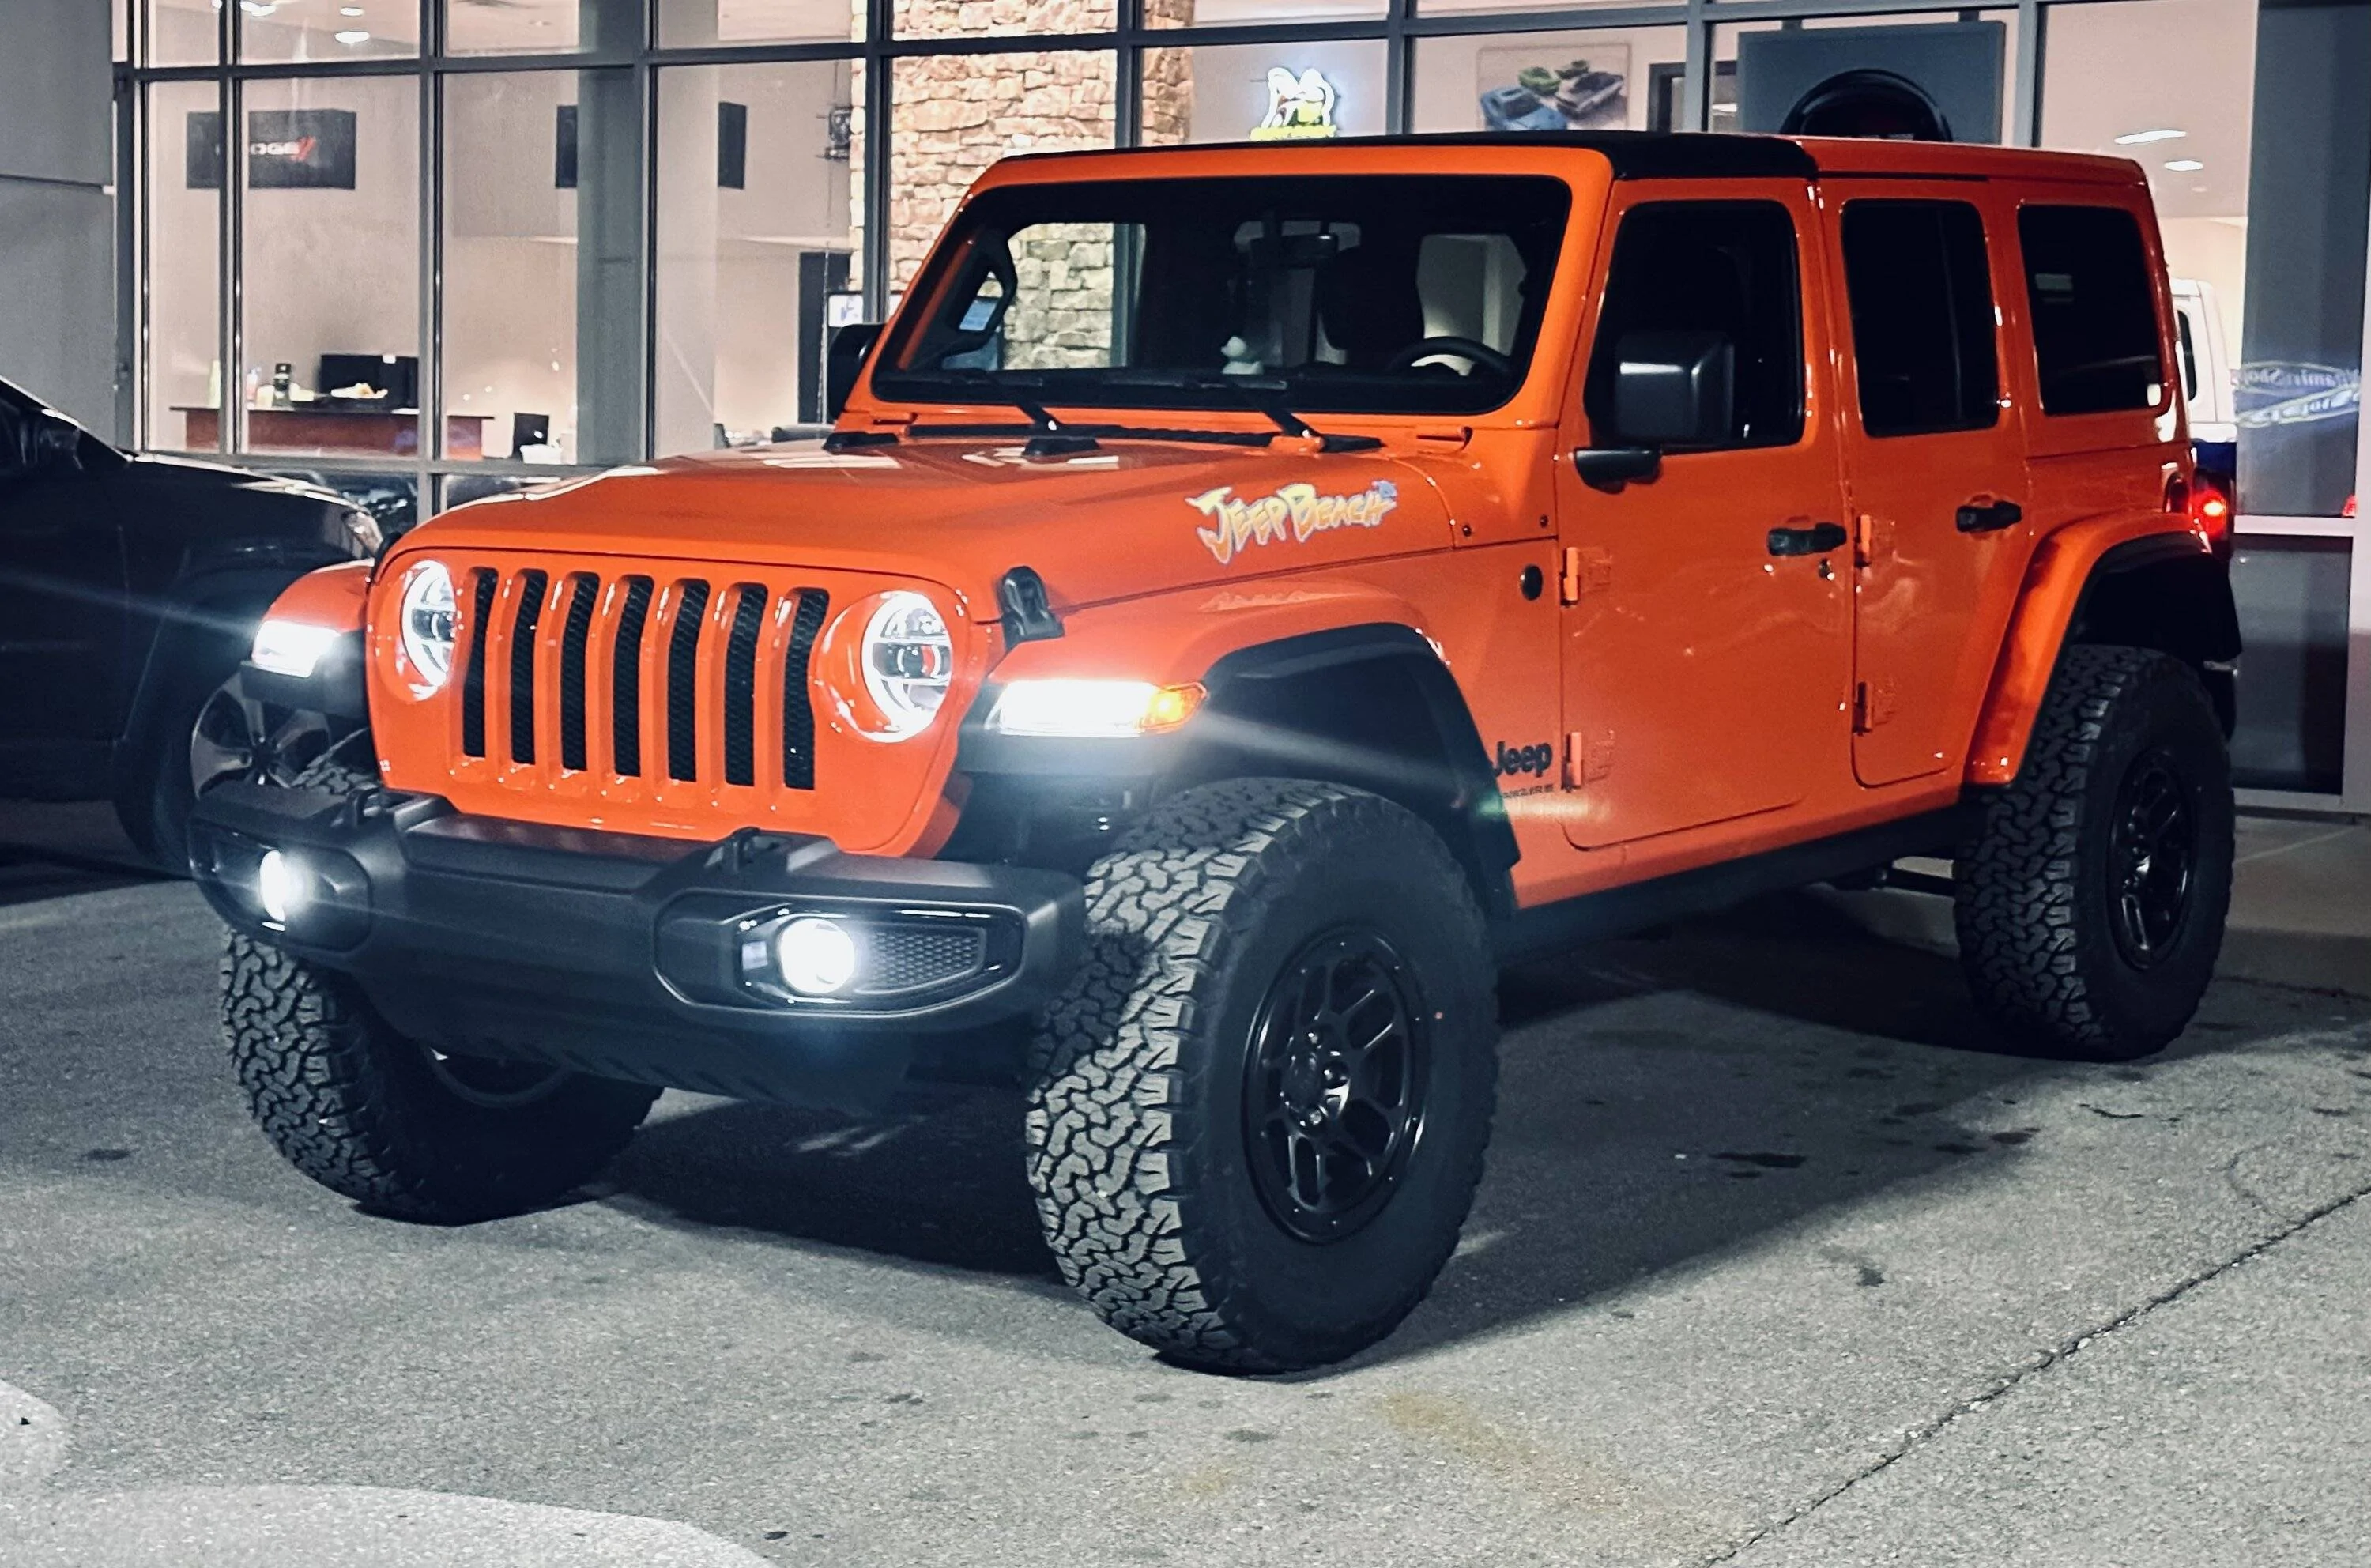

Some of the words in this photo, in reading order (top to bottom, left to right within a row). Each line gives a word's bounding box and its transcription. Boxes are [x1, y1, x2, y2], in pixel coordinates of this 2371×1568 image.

[1186, 486, 1287, 564] JEEP
[1276, 483, 1397, 543] BEACH
[1494, 741, 1553, 778] Jeep
